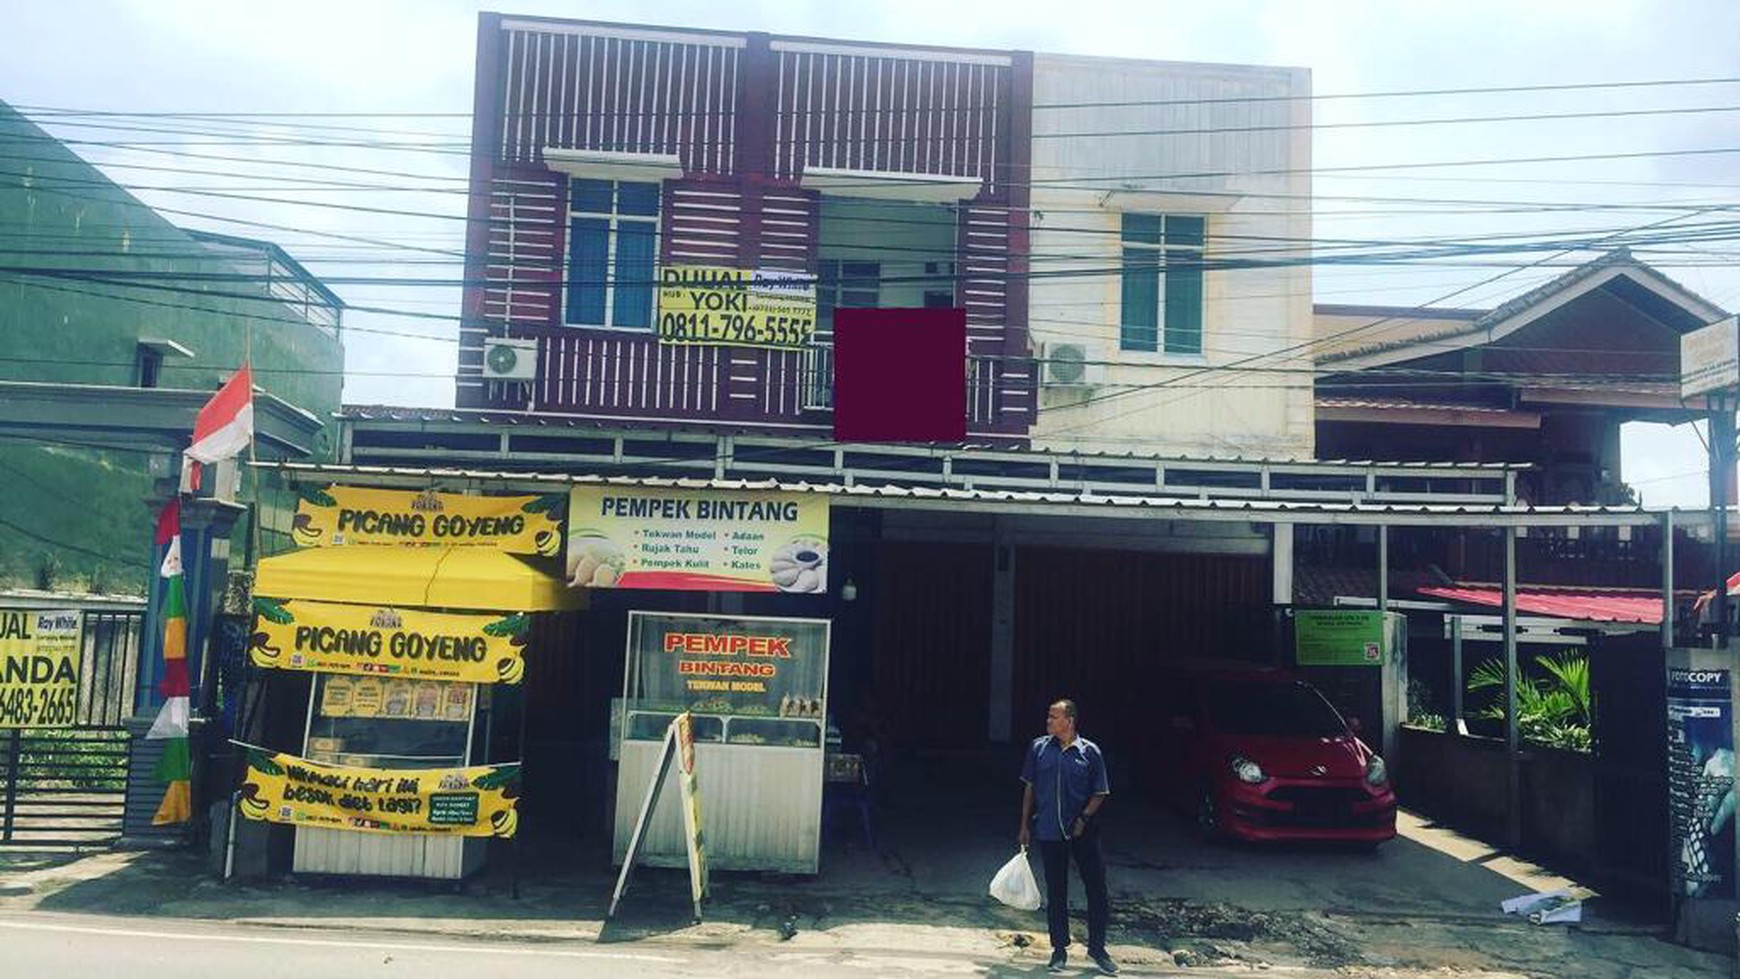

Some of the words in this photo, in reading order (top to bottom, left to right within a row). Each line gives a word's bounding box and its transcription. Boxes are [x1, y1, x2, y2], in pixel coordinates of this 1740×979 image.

[690, 291, 747, 312] YOKI
[601, 496, 690, 519] PEMPEK
[697, 499, 798, 522] BINTANG
[337, 508, 426, 537] PICANG
[433, 514, 525, 537] GOYENG
[642, 529, 683, 539] Tekwan
[686, 530, 717, 540] Model
[732, 531, 764, 540] Adaan
[641, 543, 671, 554] Rujak
[675, 544, 699, 554] Tahu
[732, 545, 758, 555] Telor
[641, 559, 682, 569] Pempek
[685, 559, 710, 569] Kulit
[38, 615, 54, 632] Ray
[295, 625, 382, 657] PICANG
[389, 631, 487, 662] GOYENG
[664, 632, 792, 658] PEMPEK
[0, 655, 77, 684] NDA
[679, 660, 776, 677] BINTANG
[686, 679, 729, 691] TEKWAN
[731, 681, 766, 692] MODEL
[352, 776, 394, 794] hari
[396, 777, 421, 794] ini
[283, 782, 335, 806] besok
